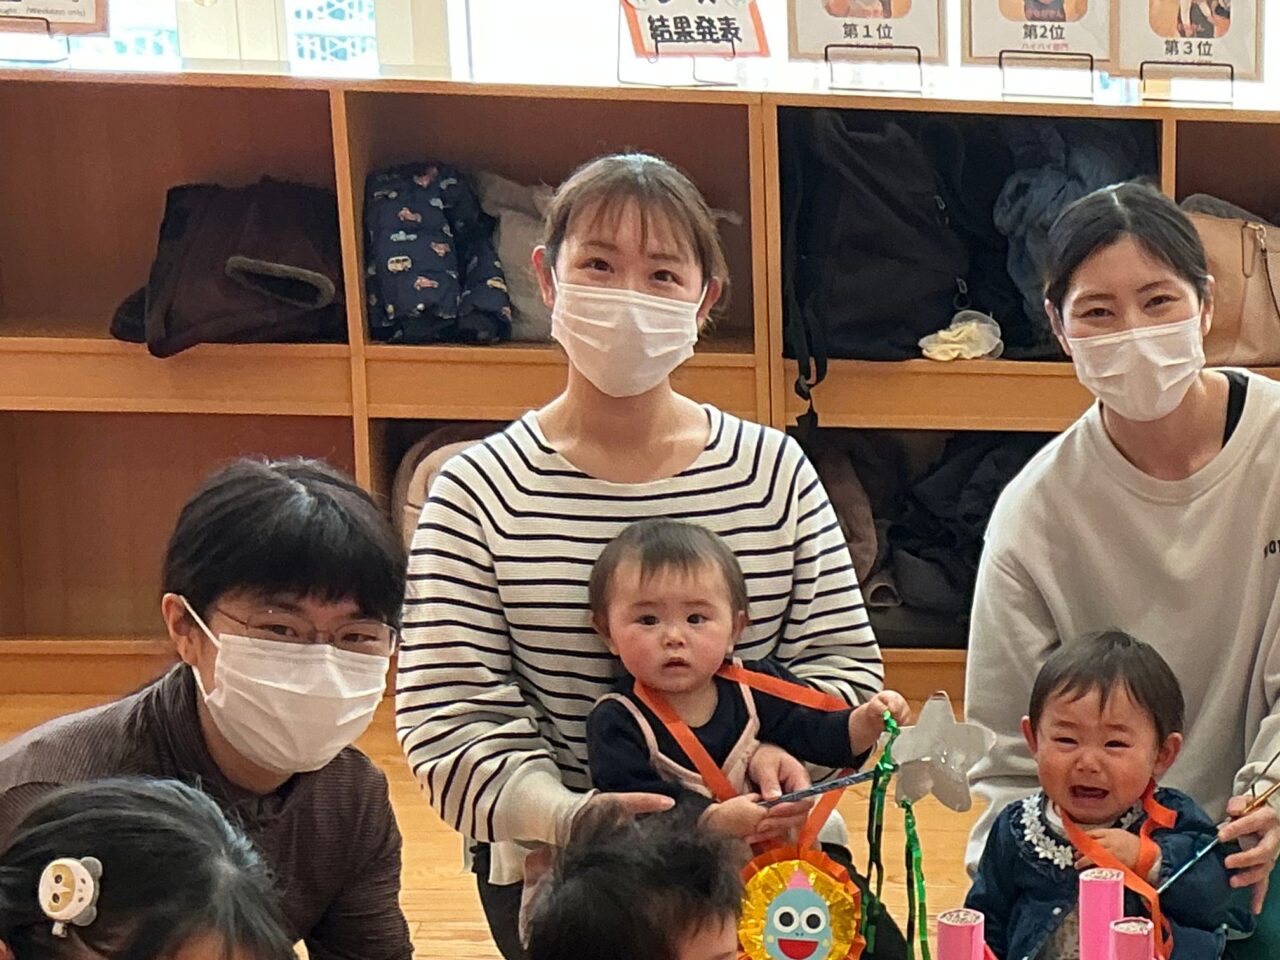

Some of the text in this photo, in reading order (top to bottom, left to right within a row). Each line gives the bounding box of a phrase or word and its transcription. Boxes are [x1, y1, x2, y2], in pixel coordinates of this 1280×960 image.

[648, 15, 742, 43] 結果発表
[842, 23, 893, 40] 第1位
[1023, 24, 1065, 40] 第2位
[1164, 40, 1212, 56] 第3位
